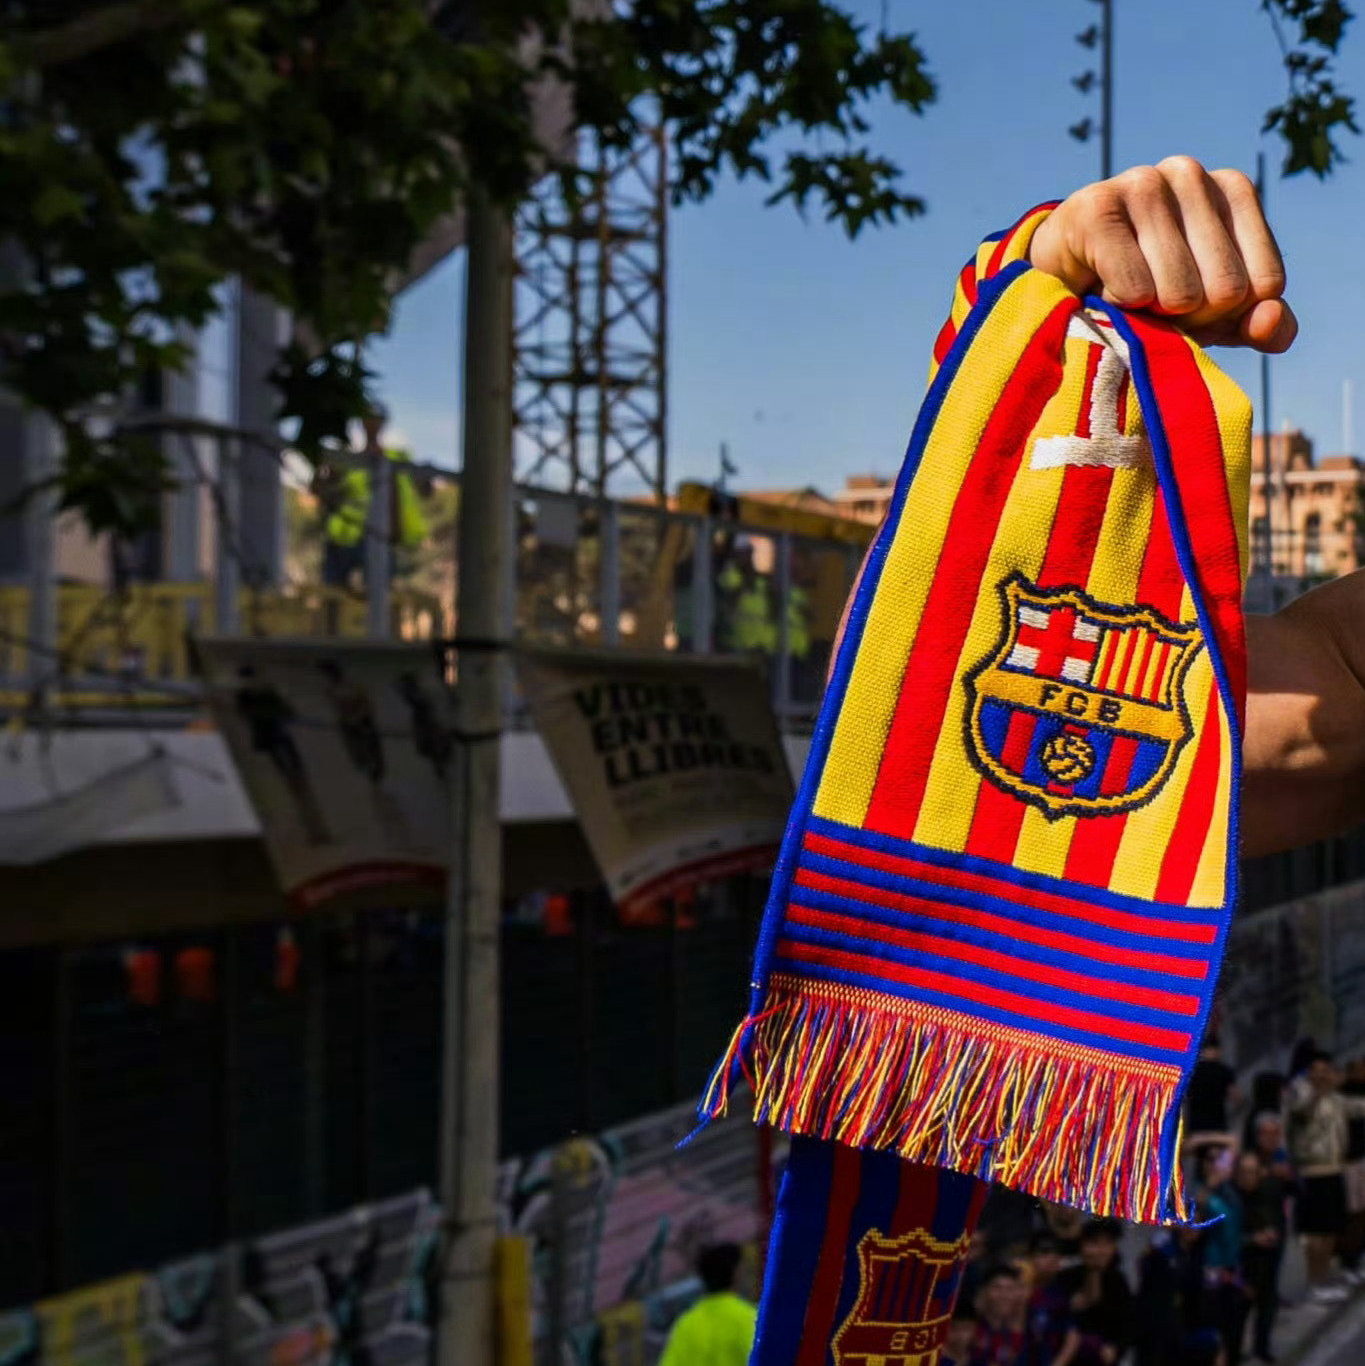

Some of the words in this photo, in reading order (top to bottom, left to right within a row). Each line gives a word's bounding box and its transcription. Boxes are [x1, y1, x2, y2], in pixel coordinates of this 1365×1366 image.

[573, 684, 708, 717] VIDES
[1039, 683, 1122, 723] FCB
[593, 713, 730, 753] ENTRE
[604, 742, 774, 787] LLIBRES
